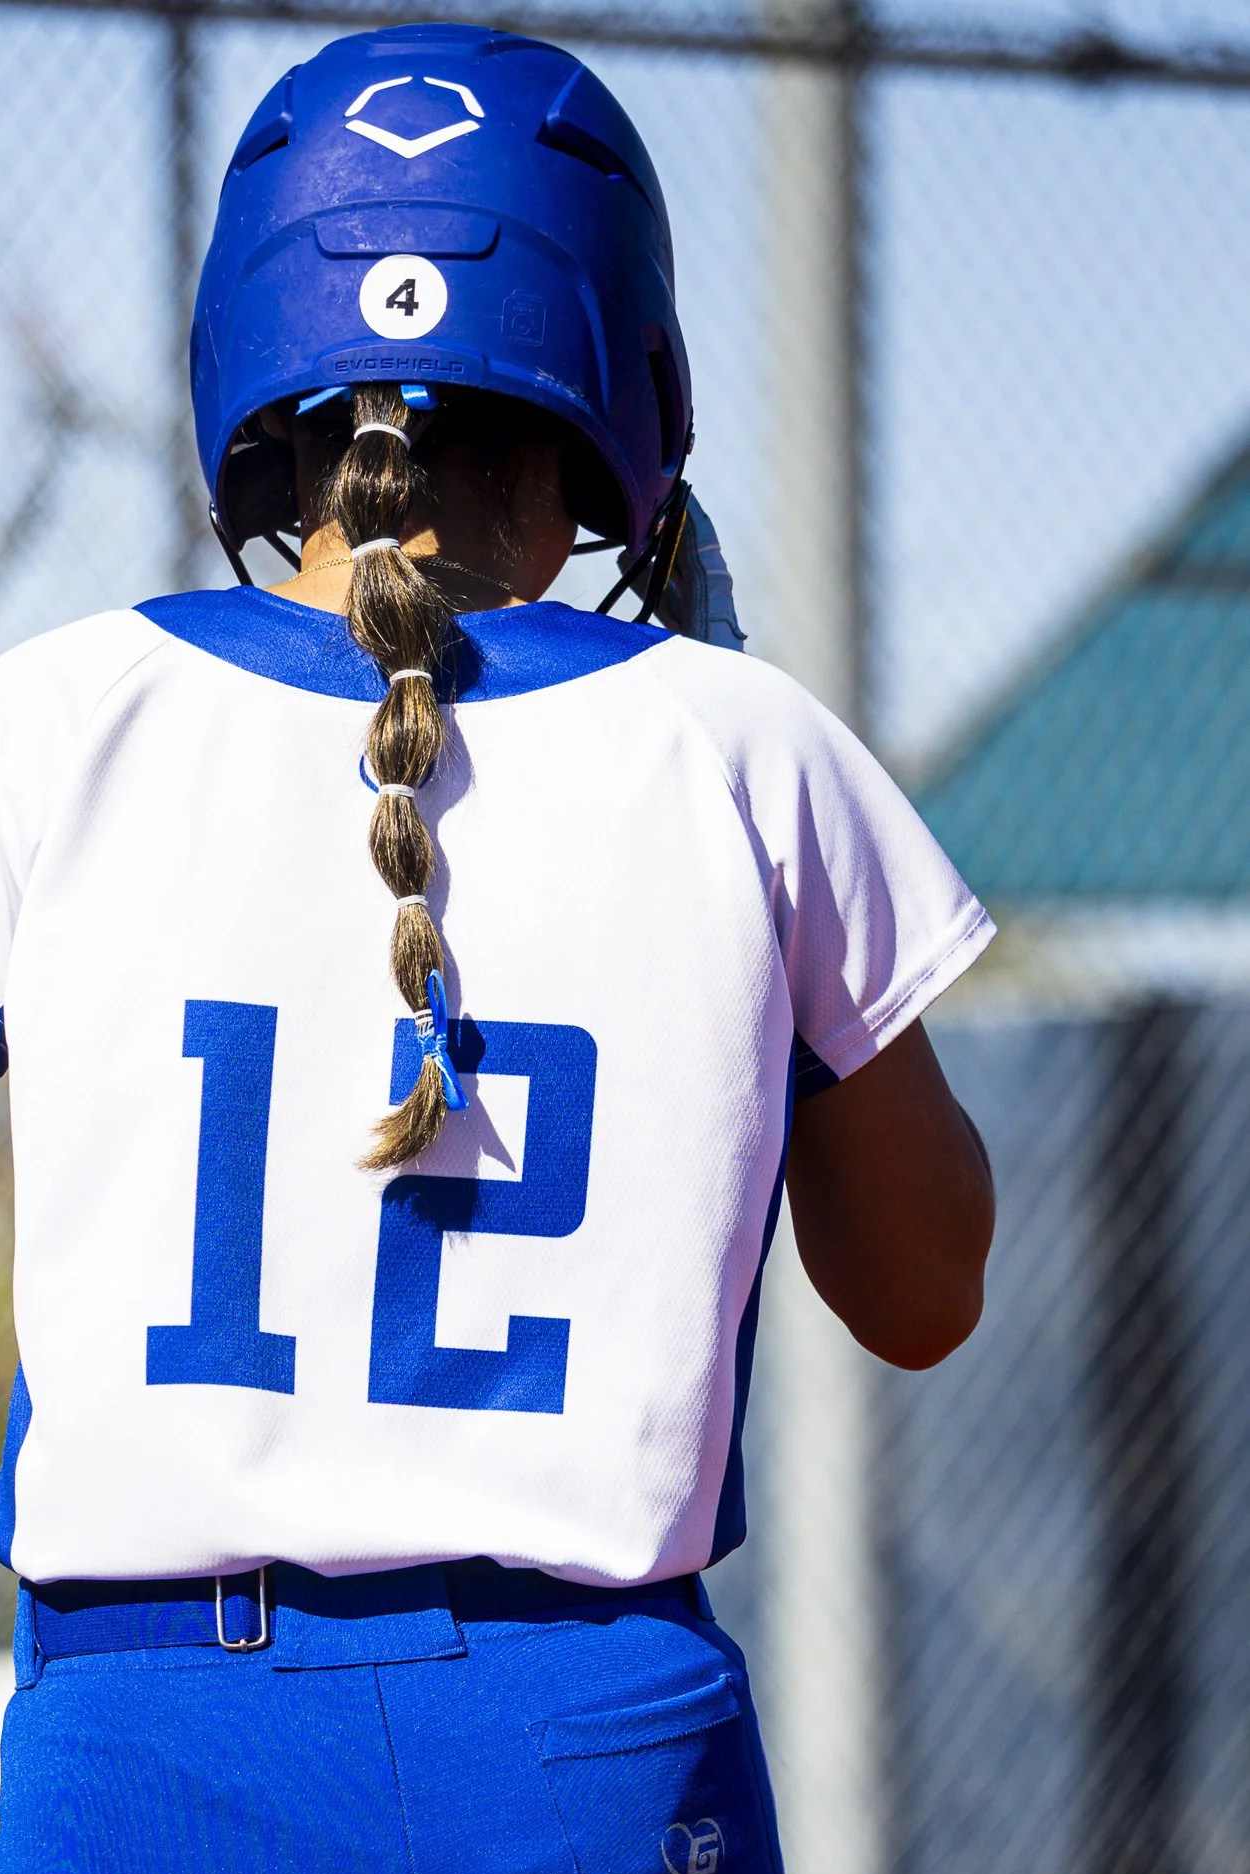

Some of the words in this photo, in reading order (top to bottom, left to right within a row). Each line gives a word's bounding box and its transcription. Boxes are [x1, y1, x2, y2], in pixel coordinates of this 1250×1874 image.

[385, 278, 419, 317] 4
[335, 357, 464, 374] EVOSHIELD
[146, 999, 598, 1415] 12
